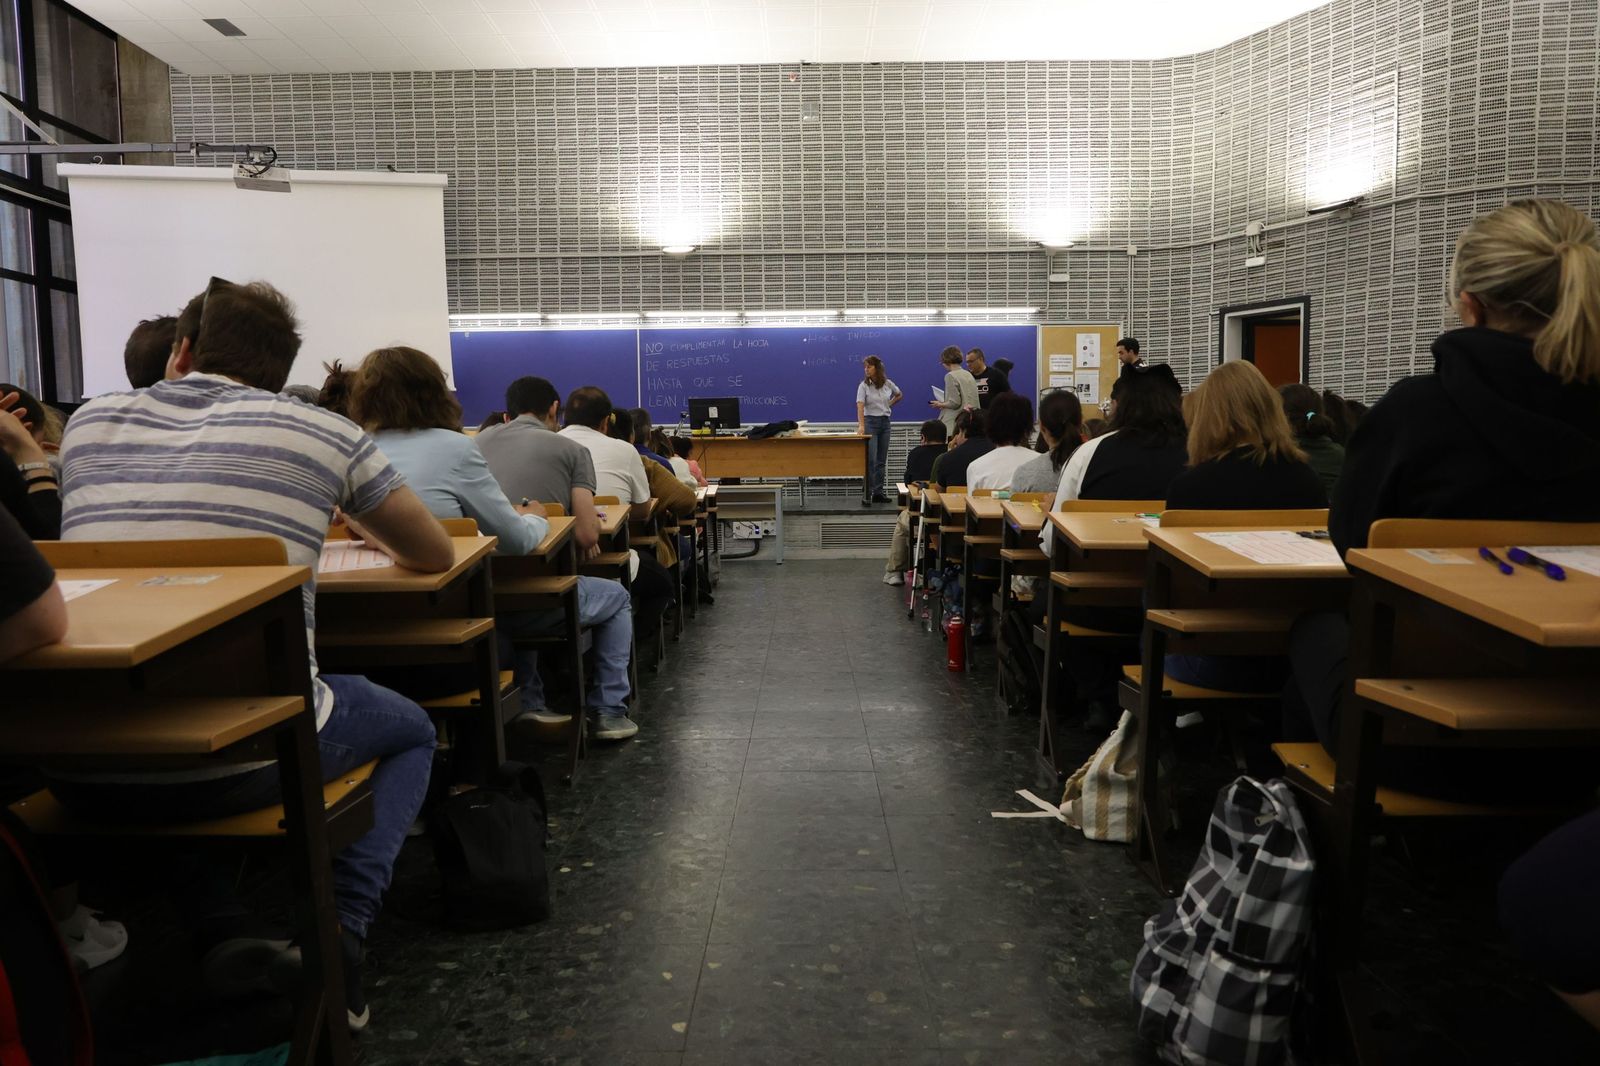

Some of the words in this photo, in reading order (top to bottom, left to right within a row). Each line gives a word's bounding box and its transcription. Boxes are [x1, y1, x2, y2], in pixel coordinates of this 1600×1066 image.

[645, 342, 664, 356] NO
[733, 339, 743, 349] LA
[646, 361, 660, 372] DE
[666, 353, 730, 369] RESPUESTAS
[647, 377, 683, 391] HASTA
[693, 376, 716, 388] QUE
[728, 374, 743, 387] SE
[648, 394, 677, 408] LEAN
[738, 395, 788, 406] TRUCCIONES
